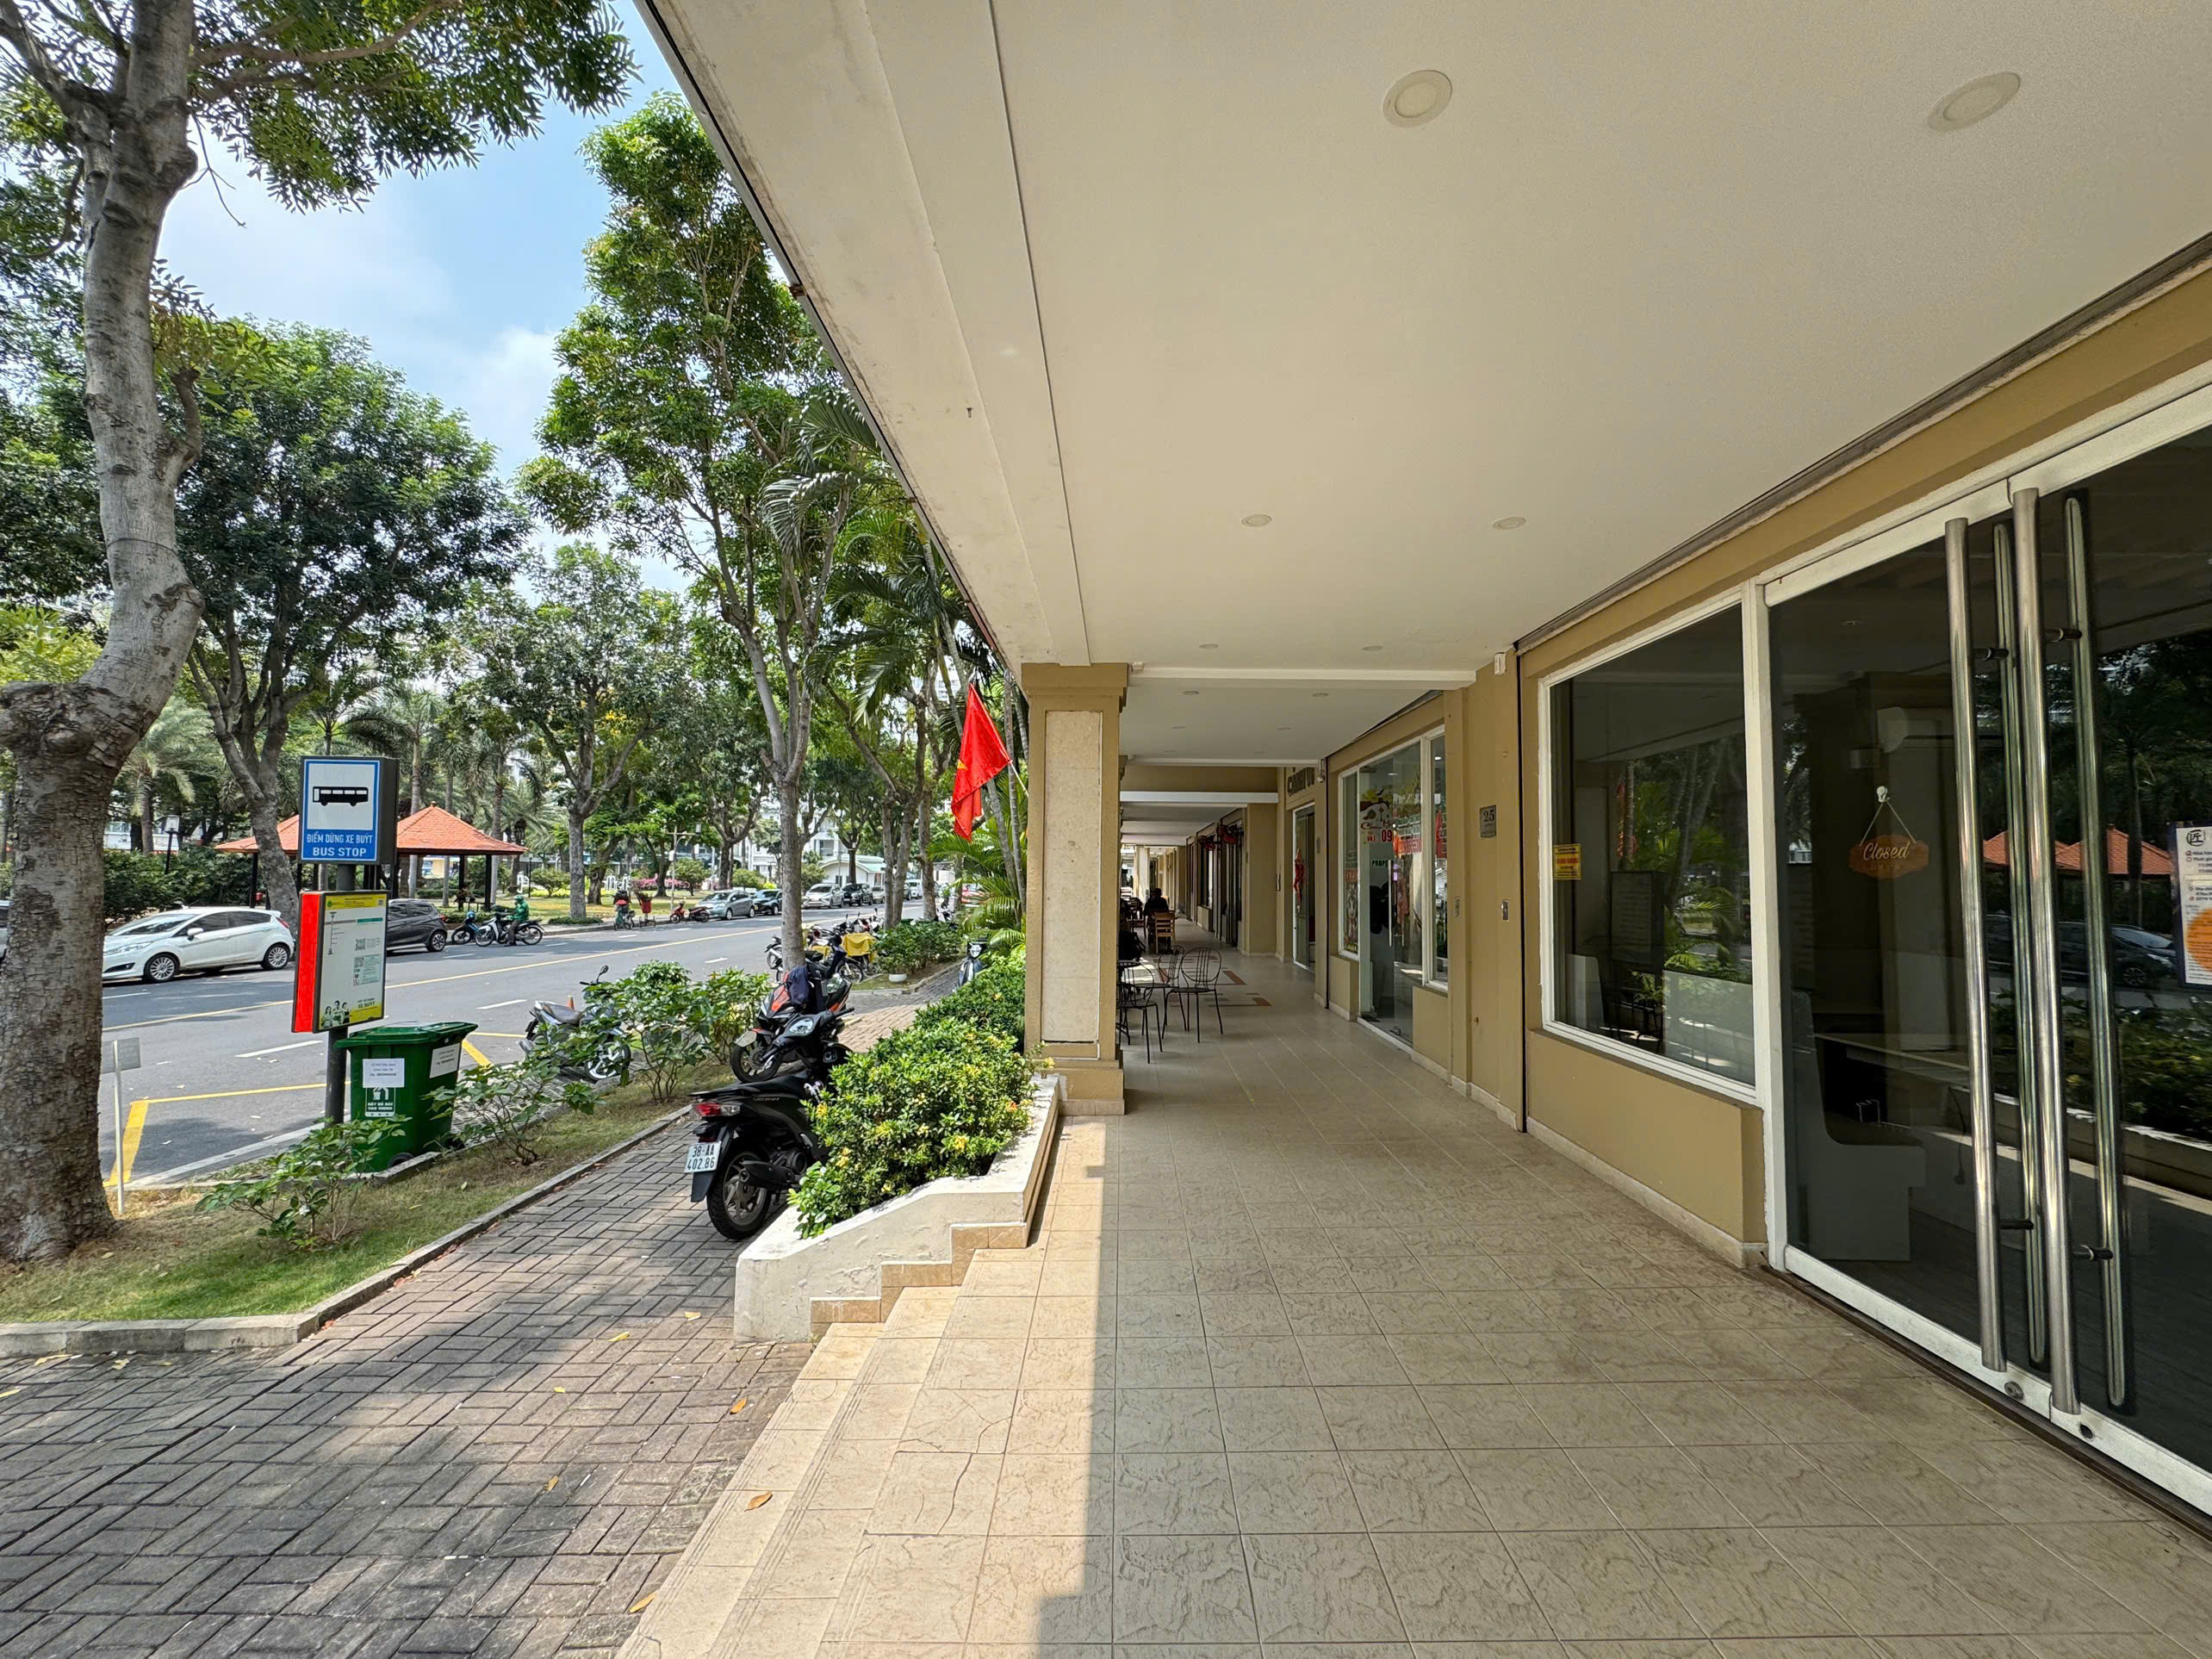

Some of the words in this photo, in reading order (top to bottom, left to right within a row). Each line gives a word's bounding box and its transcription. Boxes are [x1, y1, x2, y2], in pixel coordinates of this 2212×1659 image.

[1482, 810, 1495, 822] 25
[345, 834, 355, 844] XE
[356, 832, 373, 844] BUÝT
[313, 847, 335, 856] BUS
[338, 847, 367, 857] STOP
[1862, 841, 1910, 861] Closed
[693, 1144, 715, 1157] 38-AA
[687, 1157, 716, 1170] 402.86
